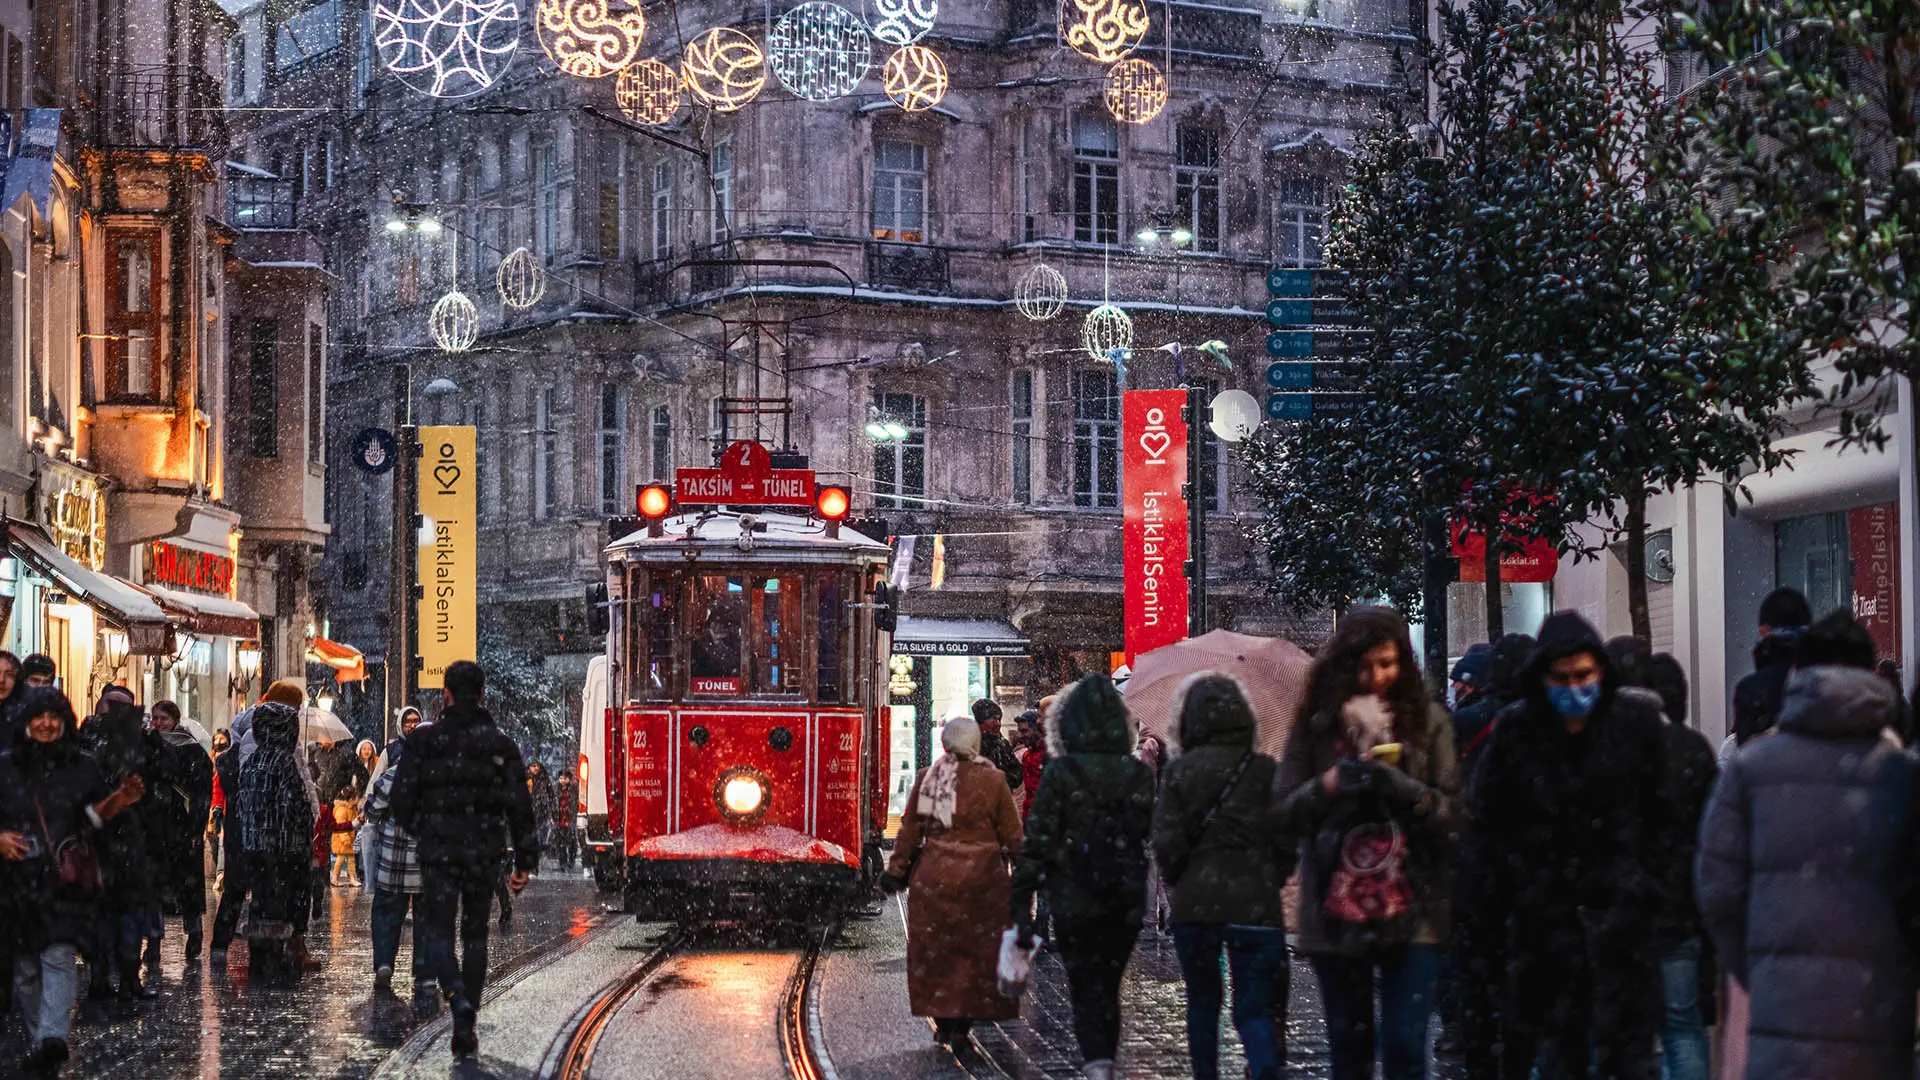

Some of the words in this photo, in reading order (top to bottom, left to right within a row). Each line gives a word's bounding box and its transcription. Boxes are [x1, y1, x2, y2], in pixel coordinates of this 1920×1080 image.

[740, 444, 751, 466] 2
[682, 474, 733, 496] TAKSİM
[762, 474, 807, 498] TÜNEL
[1143, 491, 1168, 627] istiklalSenin
[436, 520, 459, 643] istiklalSenin
[1859, 596, 1878, 617] Ziraat
[893, 643, 908, 652] ETA
[909, 643, 937, 652] SILVER
[938, 643, 945, 652] &
[946, 643, 968, 652] GOLD
[426, 666, 445, 676] istik
[697, 680, 736, 690] TÜNEL
[633, 730, 647, 748] 223
[840, 733, 854, 751] 223
